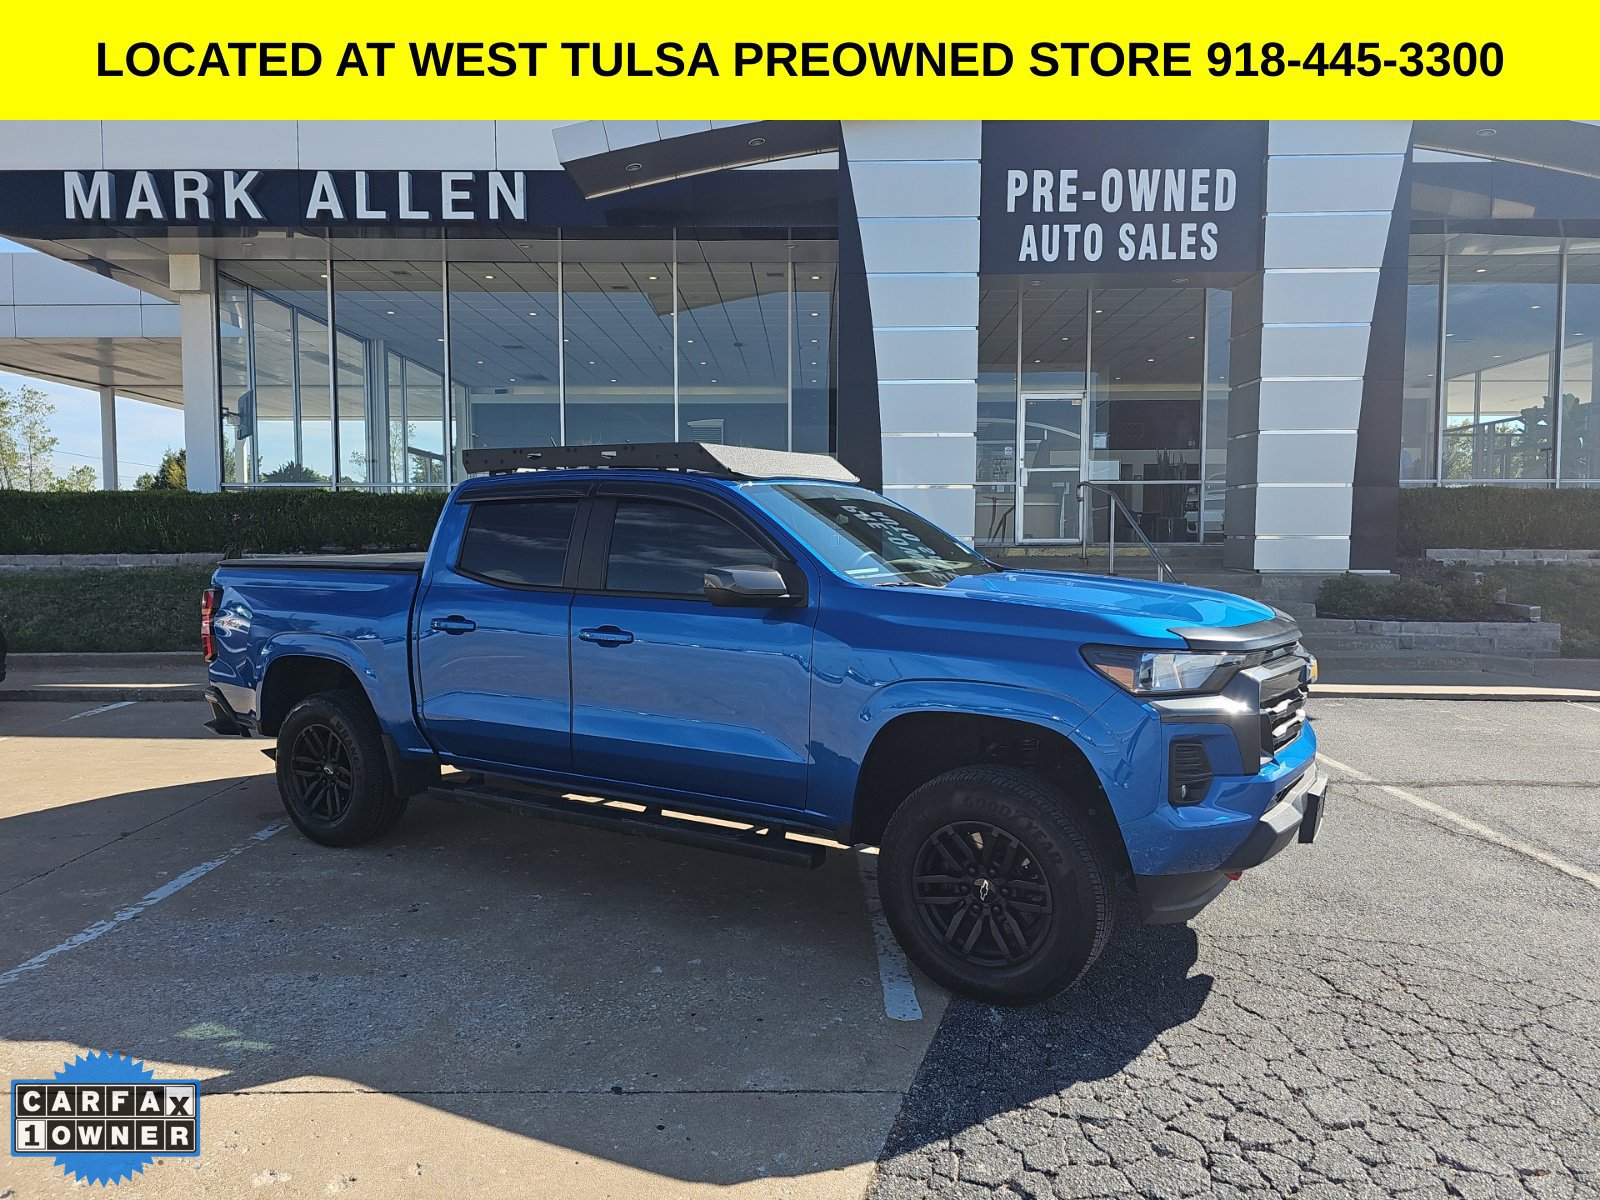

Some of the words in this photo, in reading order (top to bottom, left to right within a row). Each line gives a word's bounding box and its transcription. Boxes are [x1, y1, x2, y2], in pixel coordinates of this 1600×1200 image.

[64, 171, 264, 220] MARK
[306, 171, 527, 221] ALLEN
[1006, 168, 1238, 213] PRE-OWNED
[1018, 223, 1103, 262] AUTO
[1118, 222, 1219, 261] SALES
